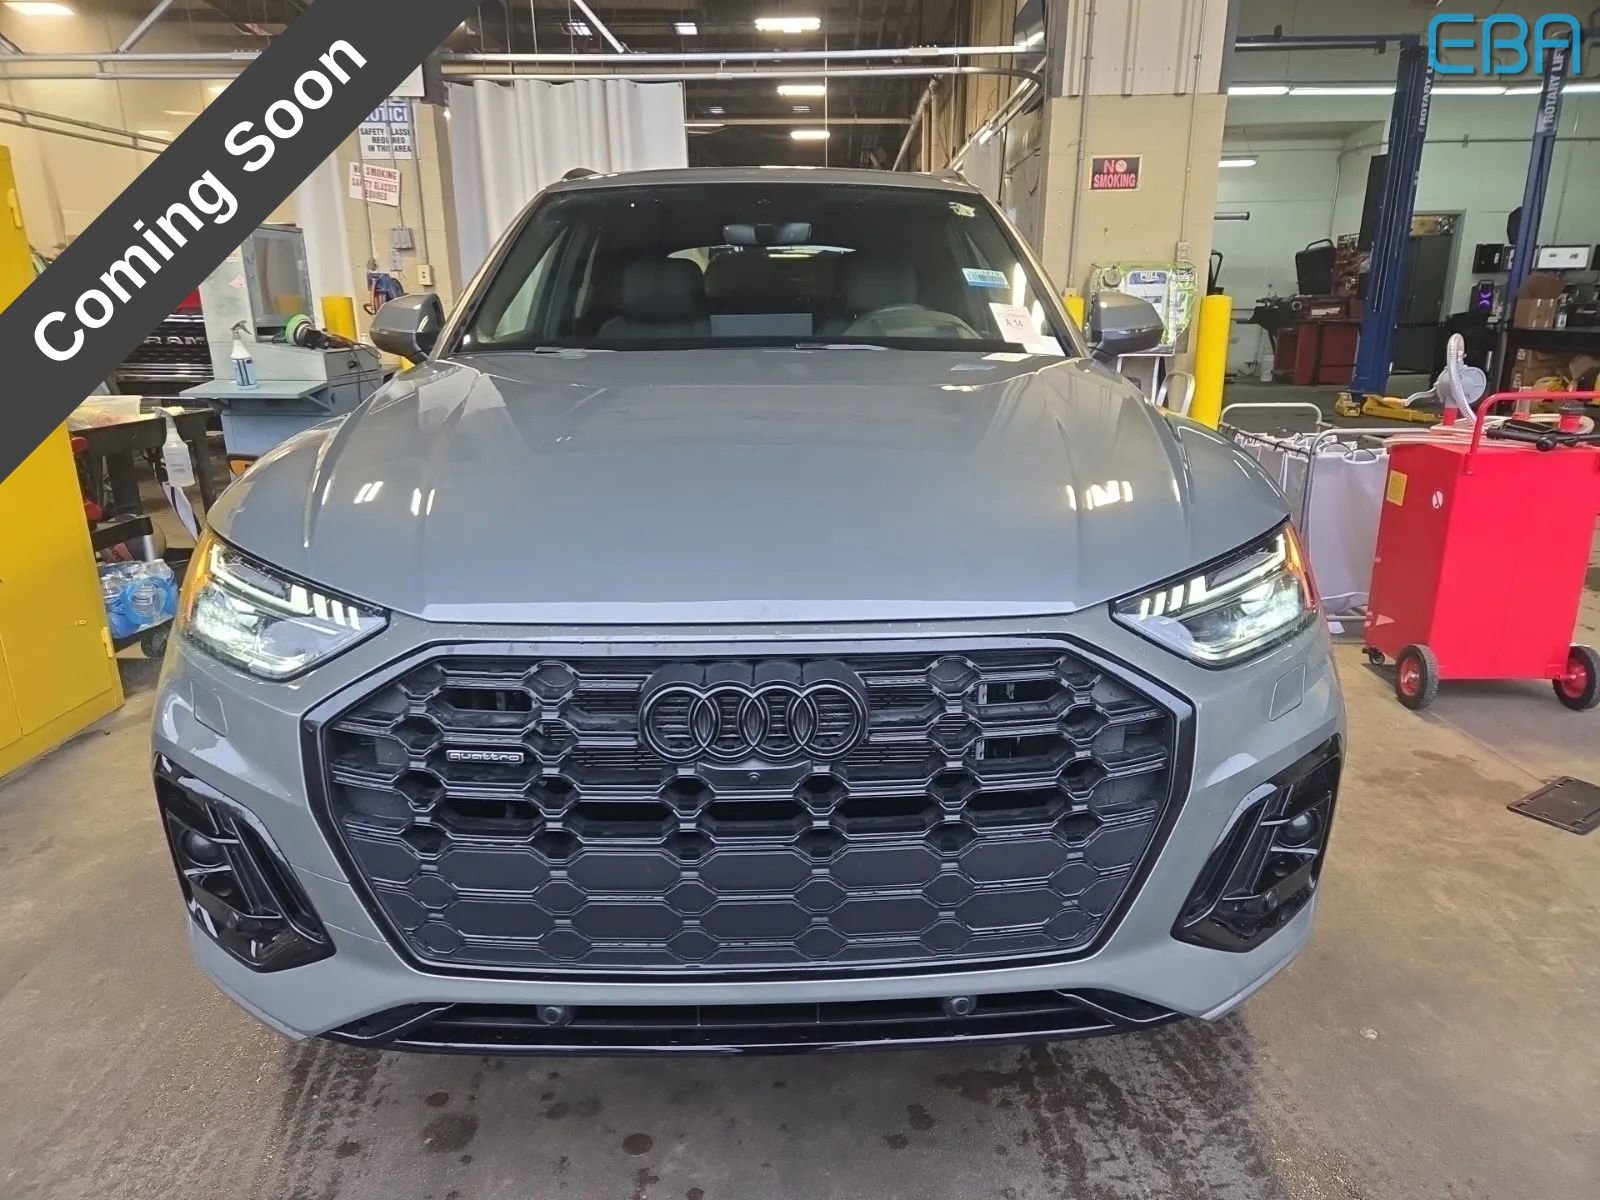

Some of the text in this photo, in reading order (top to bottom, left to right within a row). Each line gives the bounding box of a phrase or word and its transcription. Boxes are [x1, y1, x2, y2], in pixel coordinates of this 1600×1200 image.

[1419, 76, 1432, 126] ROTARY
[1543, 74, 1560, 122] ROTARY
[366, 107, 409, 121] OTIC
[360, 128, 385, 136] SAFETY
[372, 136, 405, 144] REQURED
[366, 166, 397, 180] SMOKING
[351, 178, 373, 188] SATY
[1093, 173, 1136, 188] SMOKING
[365, 189, 388, 201] EQUIRED
[143, 336, 207, 345] RAM
[449, 752, 520, 761] quattro
